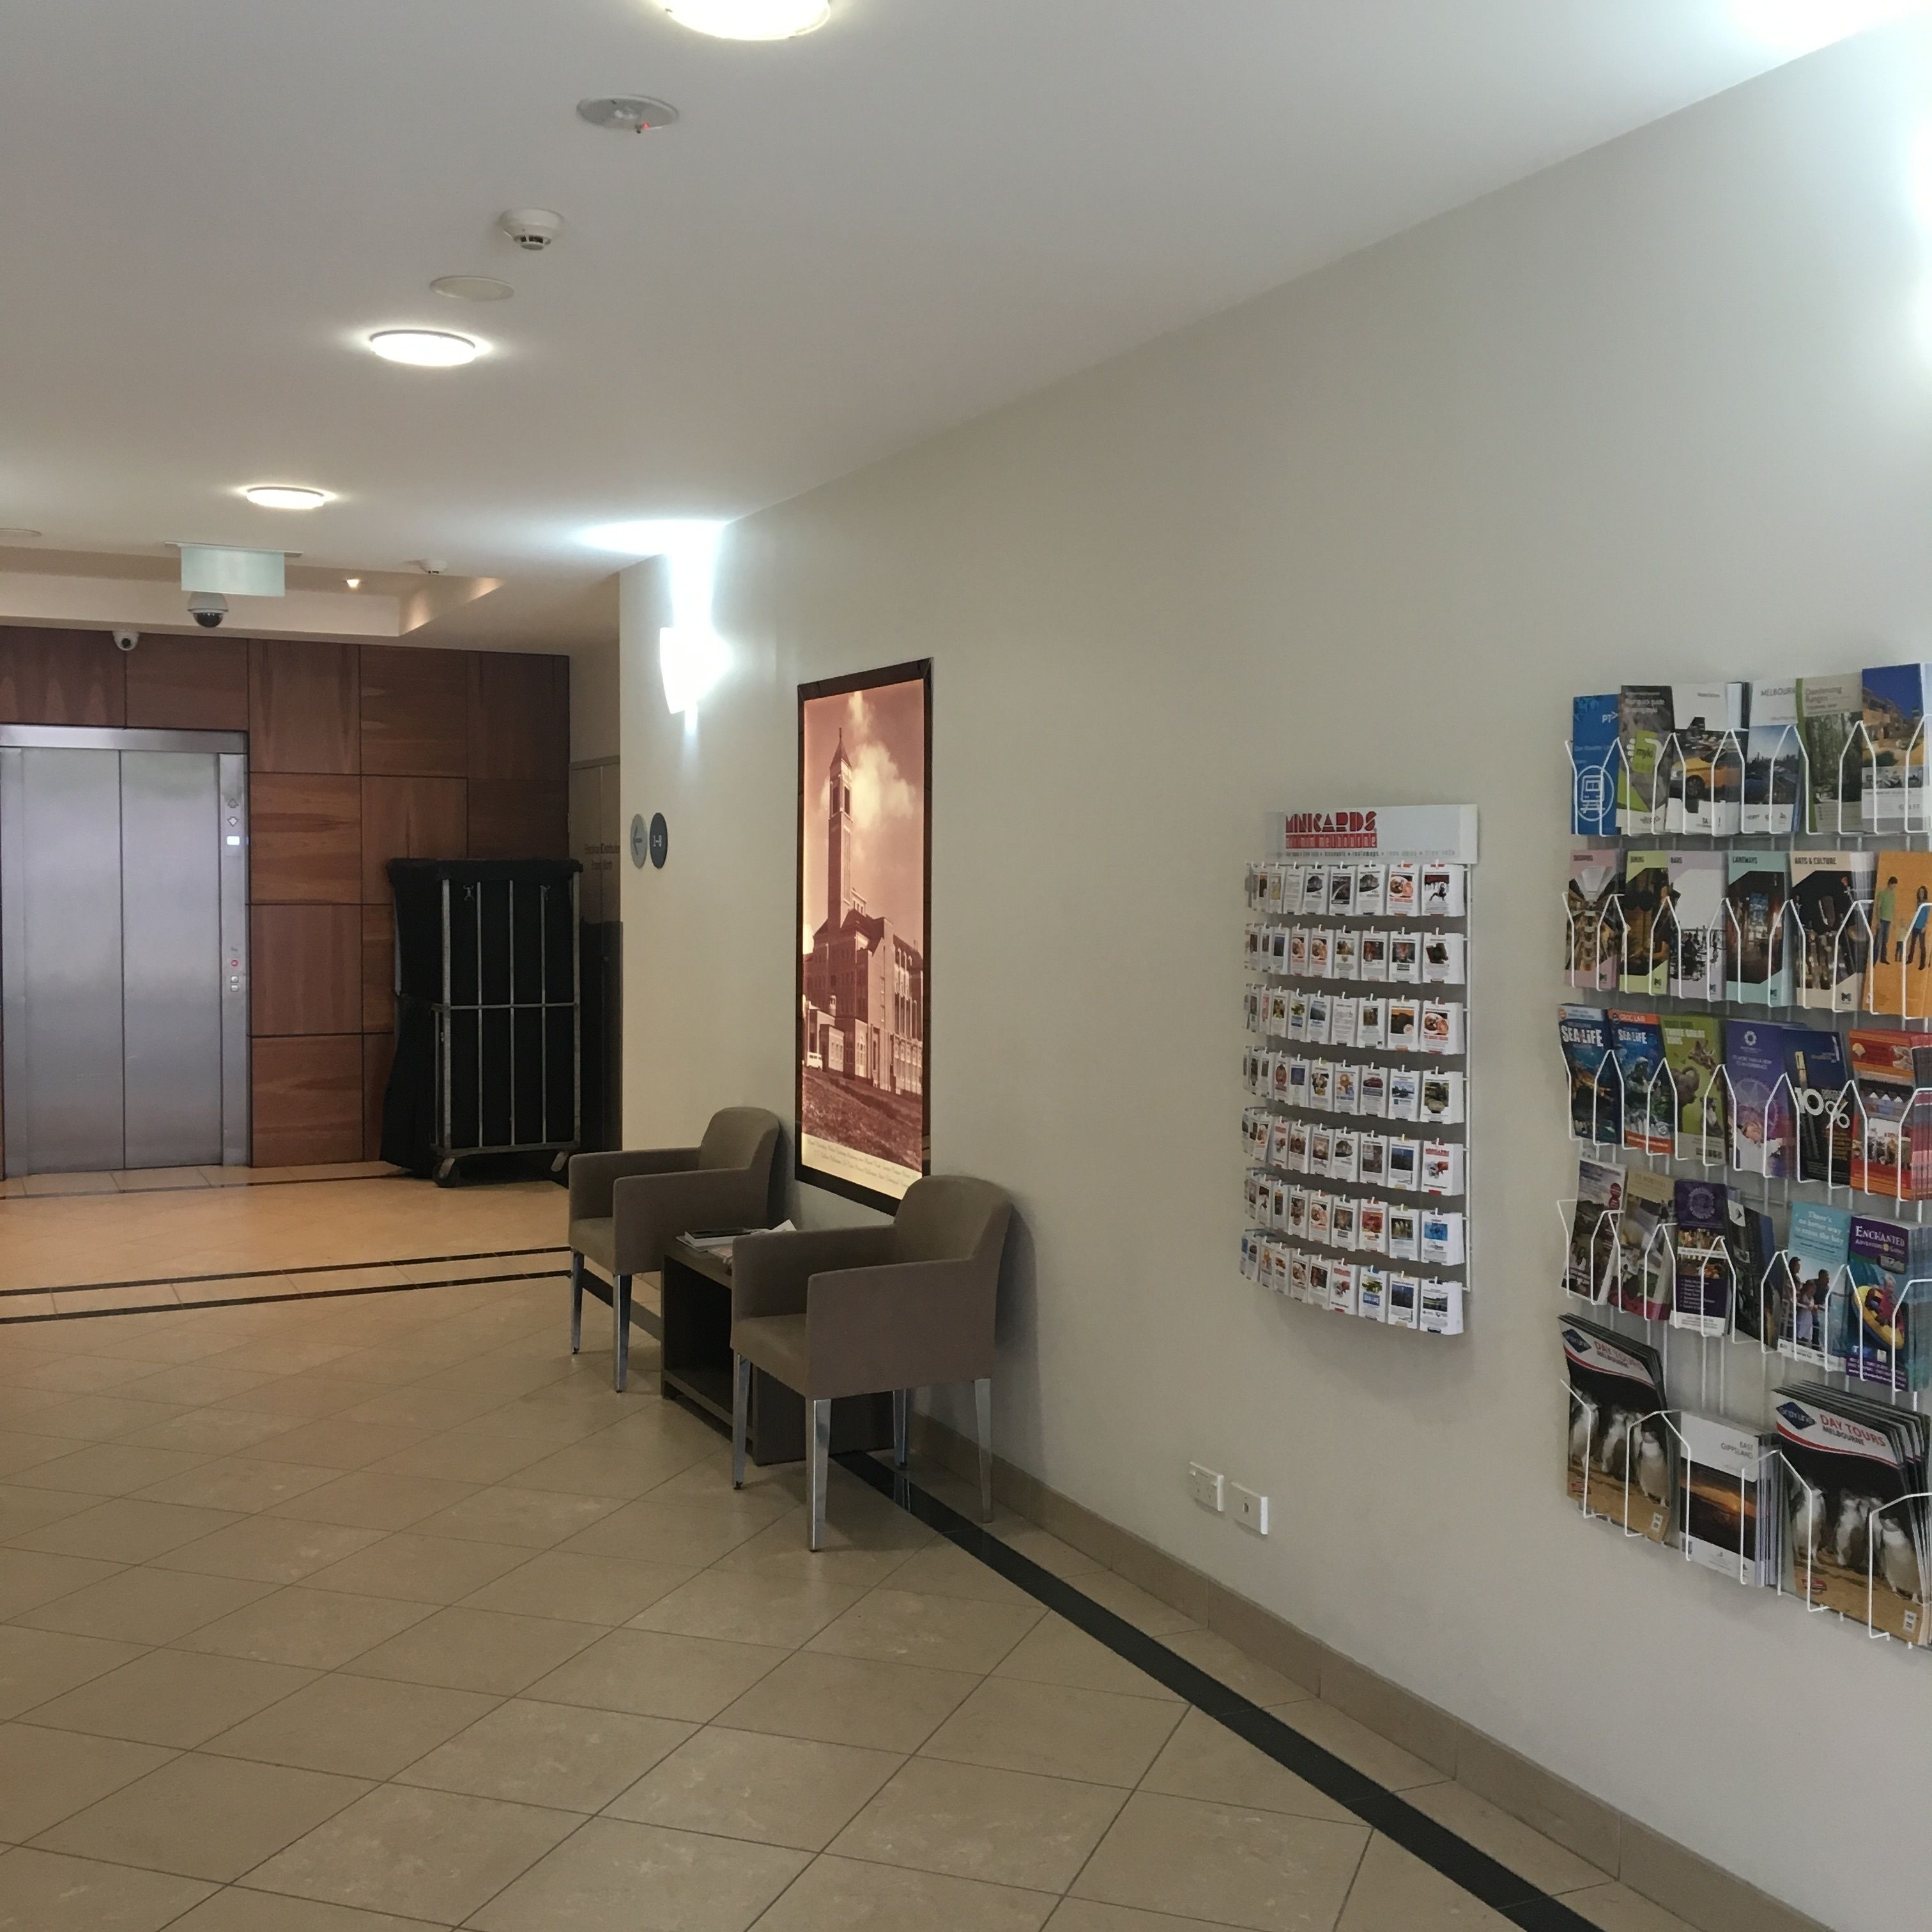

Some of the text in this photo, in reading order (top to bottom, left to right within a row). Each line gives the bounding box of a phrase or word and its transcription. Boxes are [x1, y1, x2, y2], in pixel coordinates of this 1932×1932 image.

[1760, 687, 1796, 697] MELBOURN
[1636, 748, 1653, 759] myki
[1285, 811, 1377, 833] MINICARDS
[1813, 857, 1837, 865] CULTURE
[1561, 1025, 1581, 1043] SEA
[1618, 1029, 1630, 1041] SEA
[1794, 1086, 1851, 1130] 10%
[1808, 1211, 1832, 1223] There's
[1807, 1219, 1827, 1230] better
[1827, 1227, 1843, 1236] way
[1855, 1225, 1905, 1247] ENCHANTED
[1819, 1231, 1830, 1240] the
[1830, 1234, 1845, 1246] bay
[1820, 1414, 1886, 1447] DAY TOURS
[1823, 1425, 1865, 1446] MELBOURNE
[1721, 1442, 1754, 1459] GIPPSLAND
[1740, 1441, 1754, 1452] EAST
